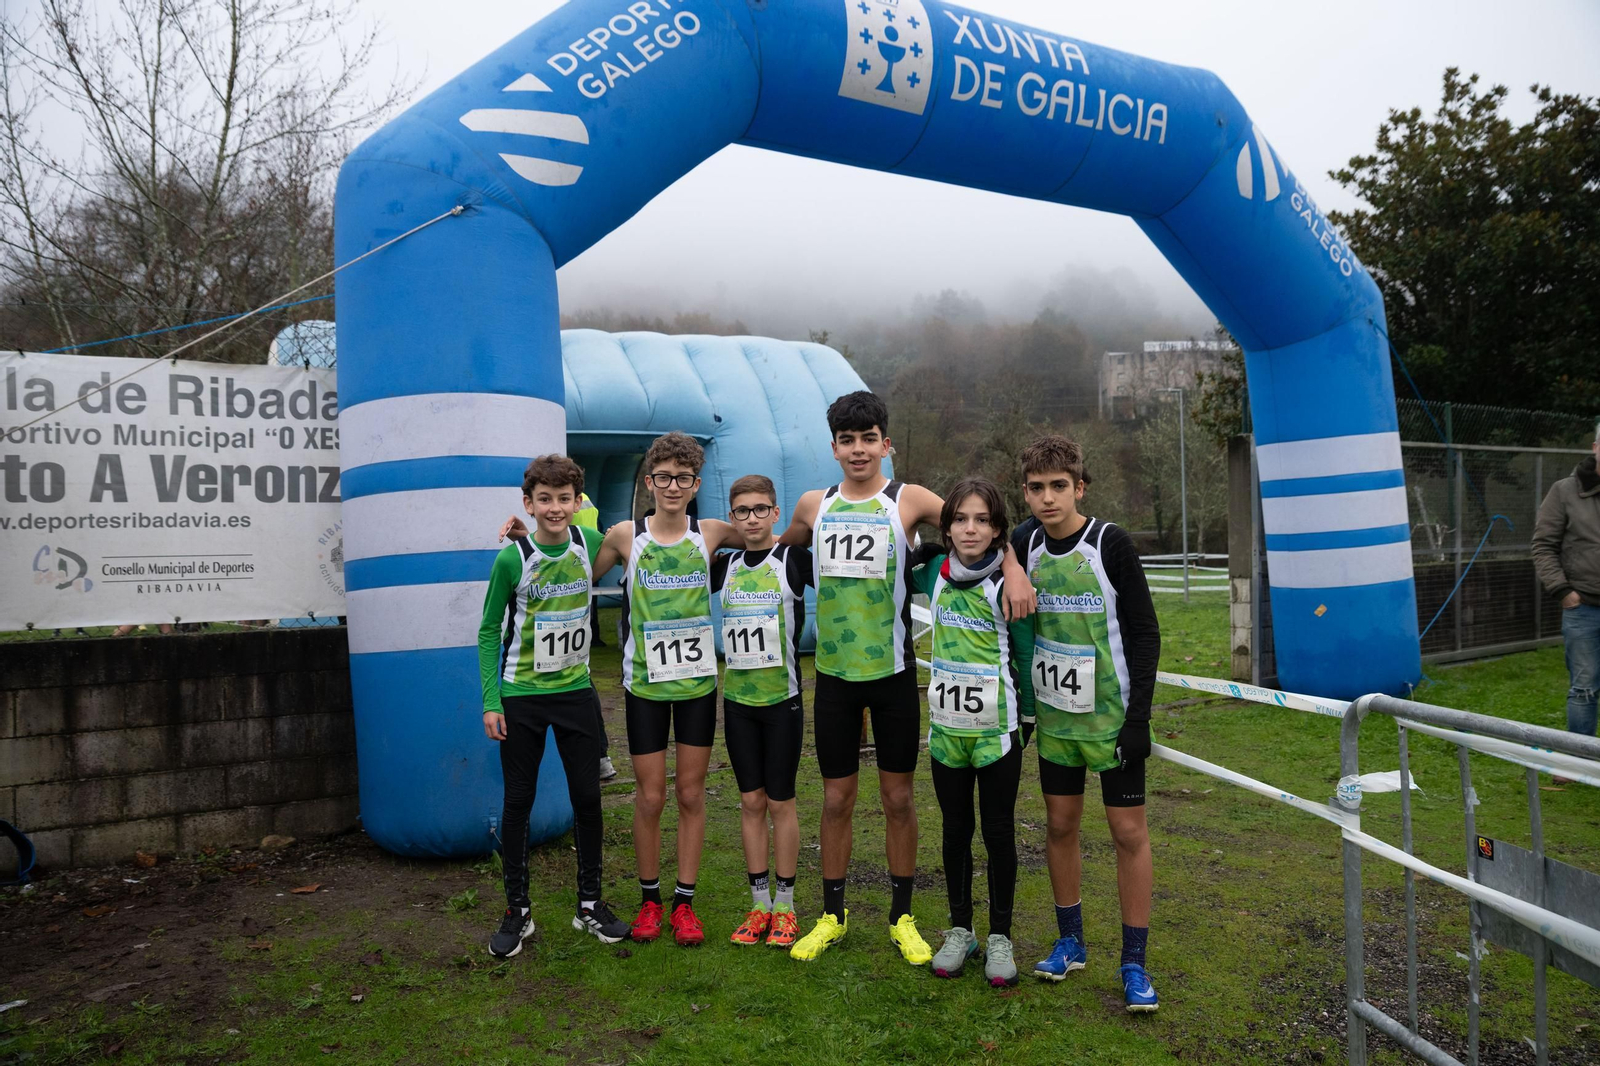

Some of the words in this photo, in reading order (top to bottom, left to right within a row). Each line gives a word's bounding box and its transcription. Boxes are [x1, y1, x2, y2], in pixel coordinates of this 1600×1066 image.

[577, 11, 701, 98] GALEGO
[943, 10, 1090, 75] XUNTA
[950, 55, 1006, 110] DE
[1017, 72, 1168, 145] GALICIA
[1291, 192, 1352, 277] GALEGO
[6, 367, 55, 411] la
[78, 372, 147, 415] de
[113, 424, 254, 453] Municipal
[0, 455, 65, 503] to
[90, 454, 128, 503] A
[149, 455, 342, 503] Veronz
[825, 534, 875, 561] 112
[102, 563, 145, 576] Consello
[148, 562, 196, 577] Municipal
[199, 562, 210, 574] de
[213, 561, 255, 576] Deportes
[638, 569, 706, 588] Natursueño
[137, 583, 222, 594] RIBADAVIA
[530, 579, 588, 599] Natursueño
[1037, 590, 1102, 606] atursueño
[541, 628, 585, 656] 110
[652, 638, 703, 666] 113
[728, 627, 765, 653] 111
[1036, 661, 1081, 695] 114
[935, 682, 984, 714] 115
